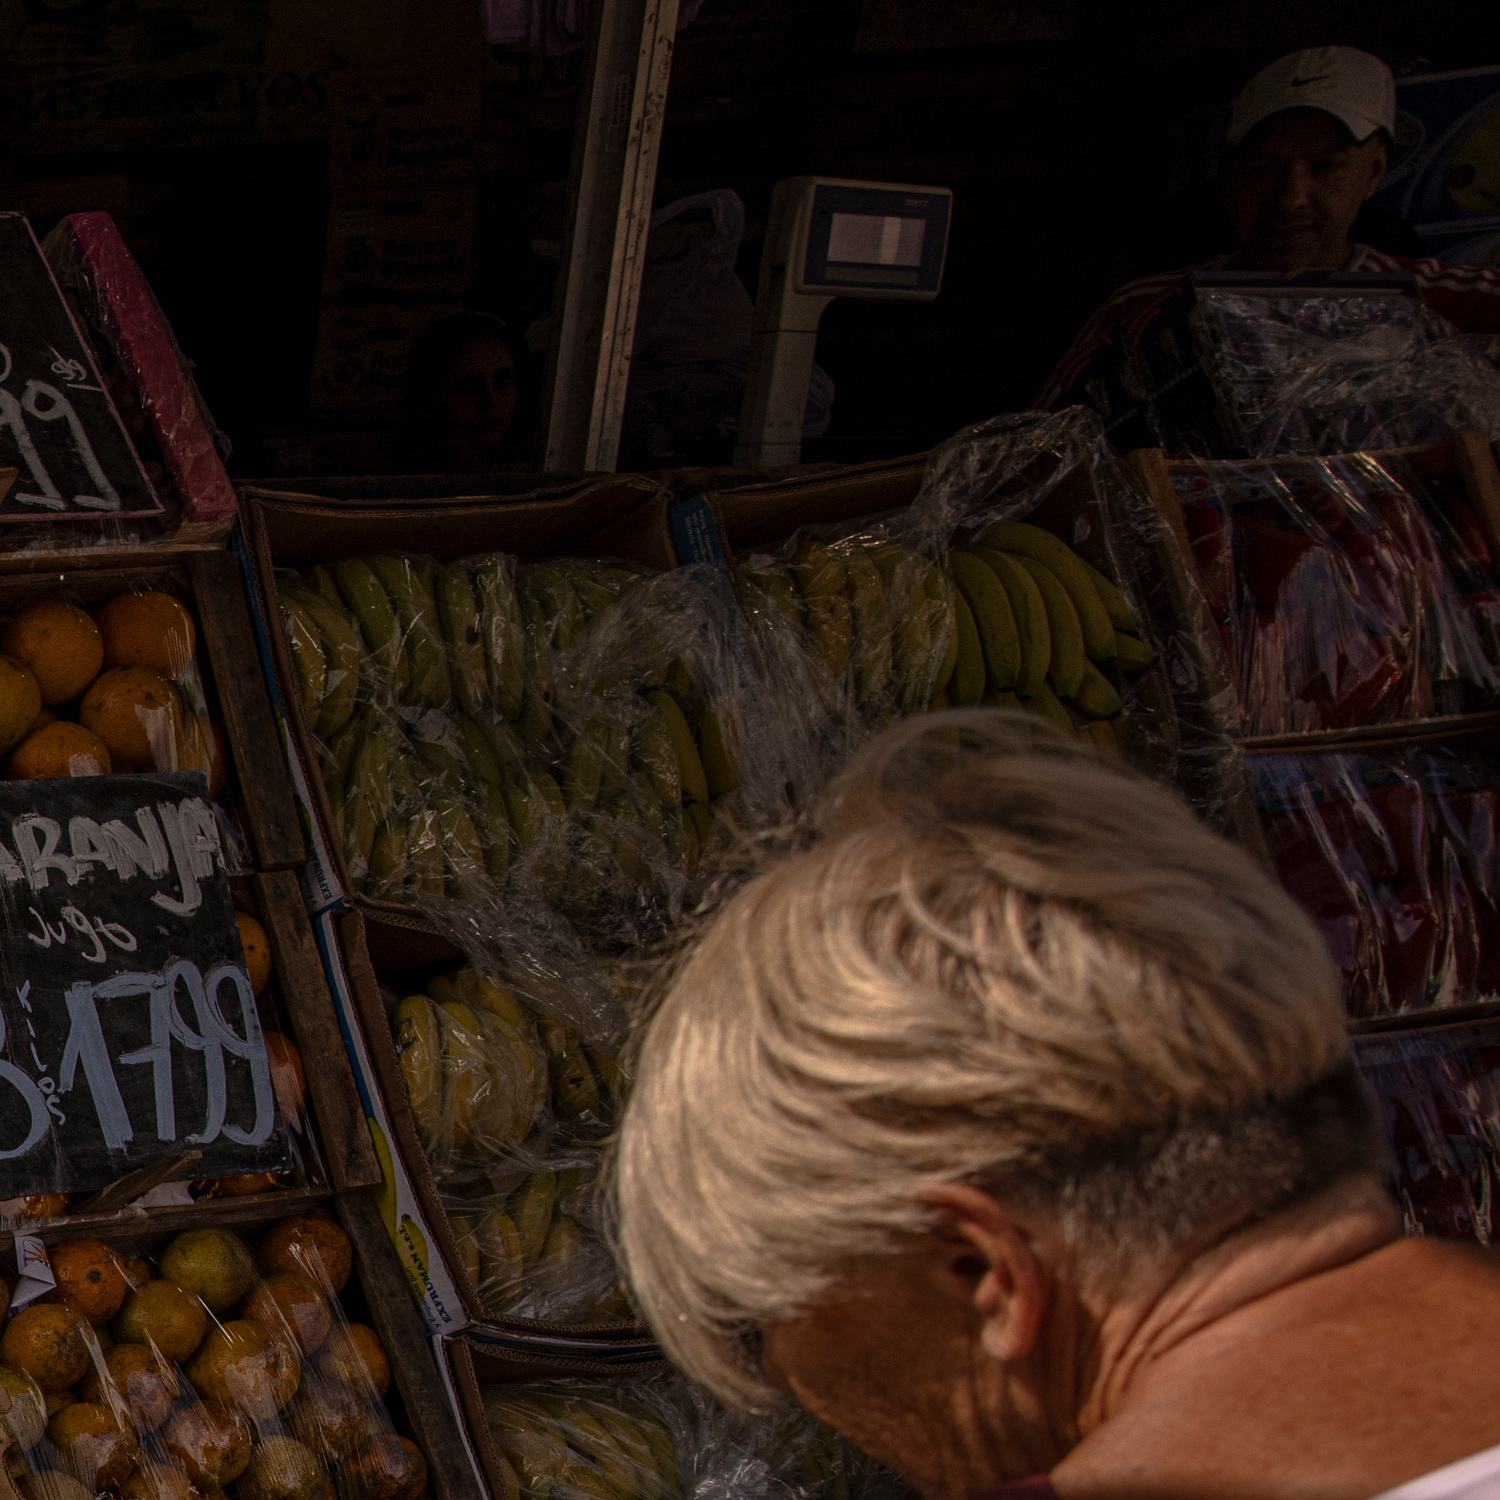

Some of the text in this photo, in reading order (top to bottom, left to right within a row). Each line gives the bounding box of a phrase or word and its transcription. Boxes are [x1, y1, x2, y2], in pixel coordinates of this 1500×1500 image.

[235, 68, 331, 111] VOS
[57, 954, 275, 1150] 1799
[410, 1252, 453, 1324] EXFRUMAN
